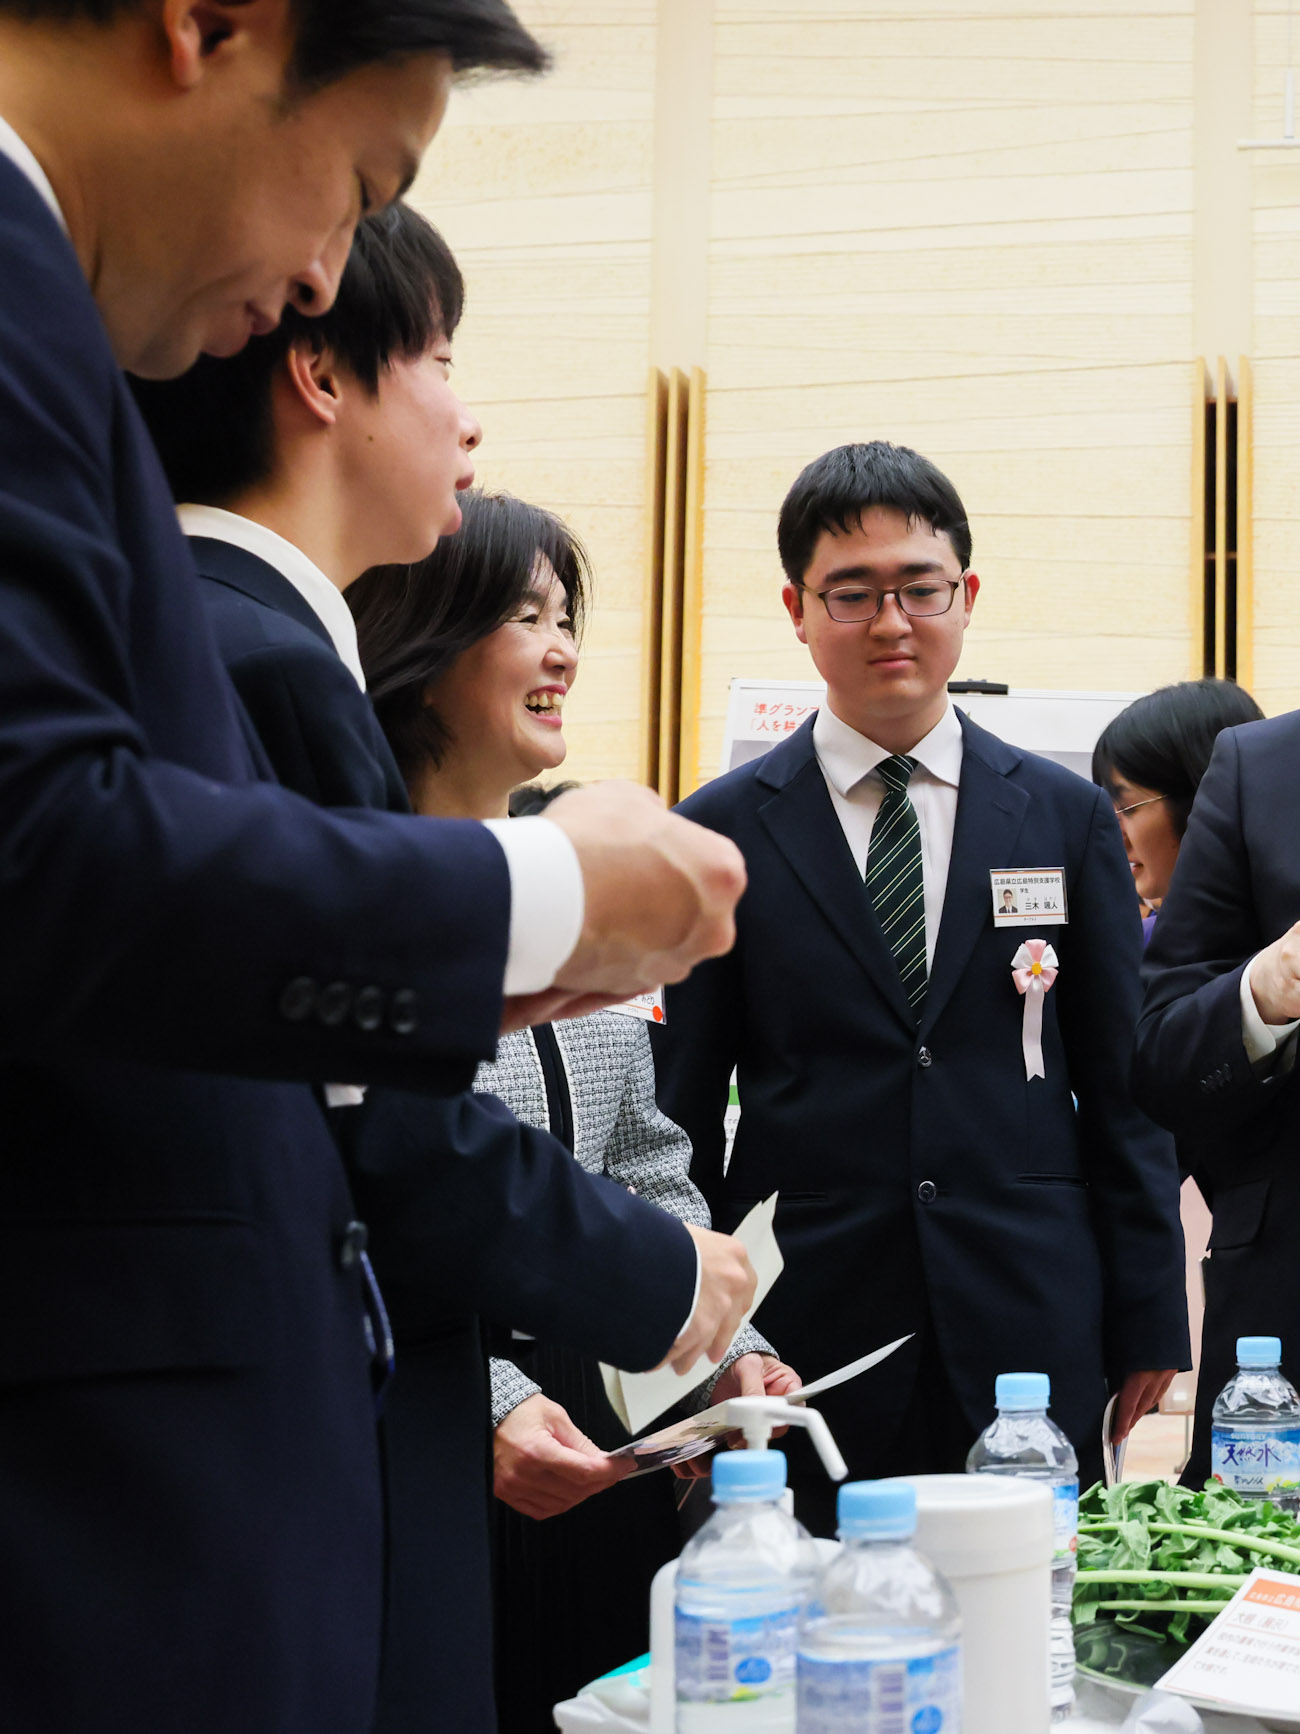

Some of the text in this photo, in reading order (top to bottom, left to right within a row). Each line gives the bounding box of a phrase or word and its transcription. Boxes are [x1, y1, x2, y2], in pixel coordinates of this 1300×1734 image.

[751, 717, 803, 732] 「人を耕
[1025, 901, 1039, 911] 三木
[1222, 1443, 1281, 1467] 天然水
